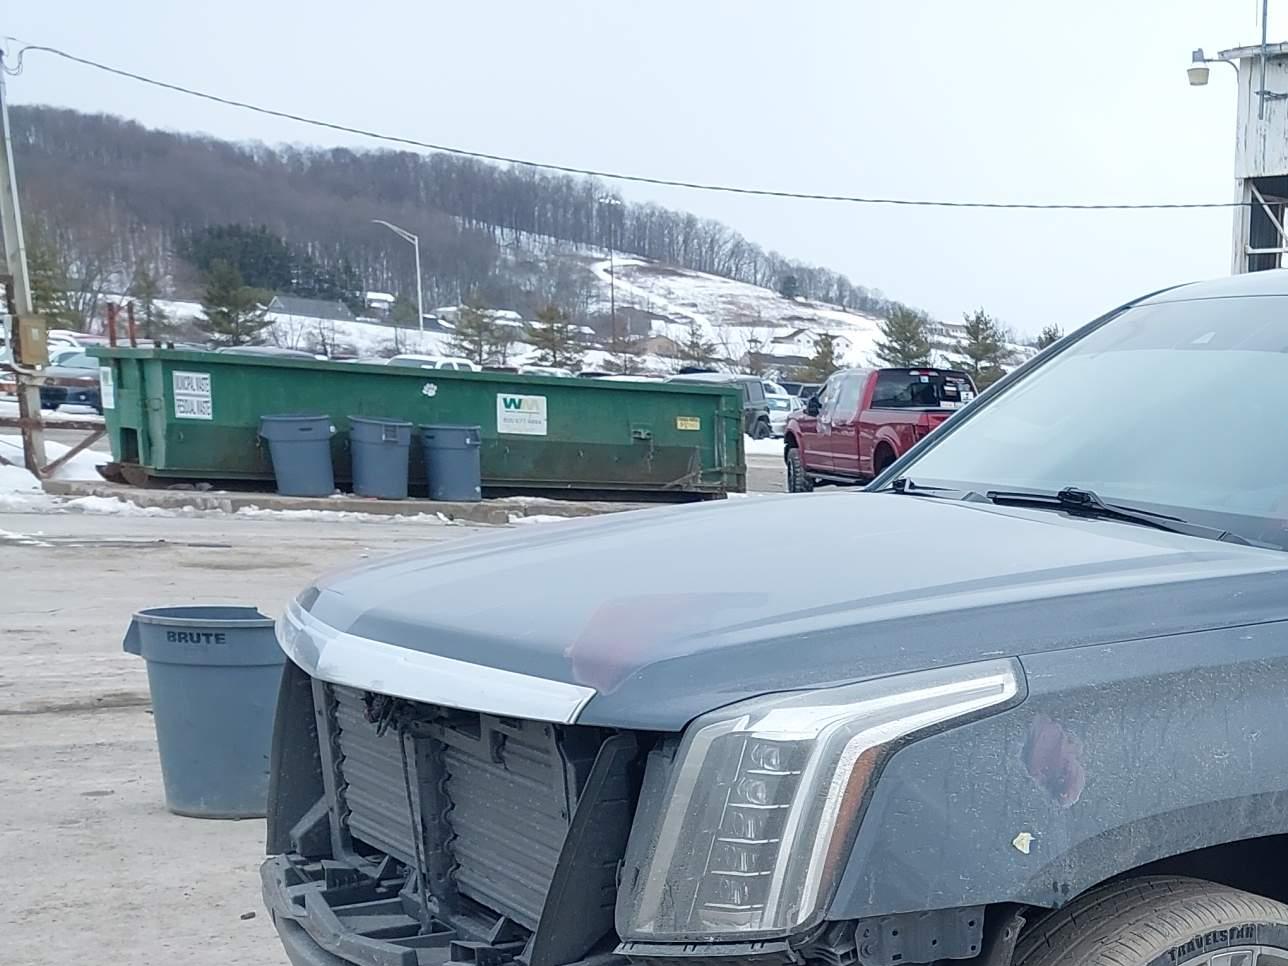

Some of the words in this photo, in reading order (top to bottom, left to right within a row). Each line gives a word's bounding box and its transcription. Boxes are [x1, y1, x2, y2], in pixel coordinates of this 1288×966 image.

[503, 398, 540, 410] WM
[167, 631, 226, 644] BRUTE
[1168, 924, 1255, 961] TRAVELSTAR
